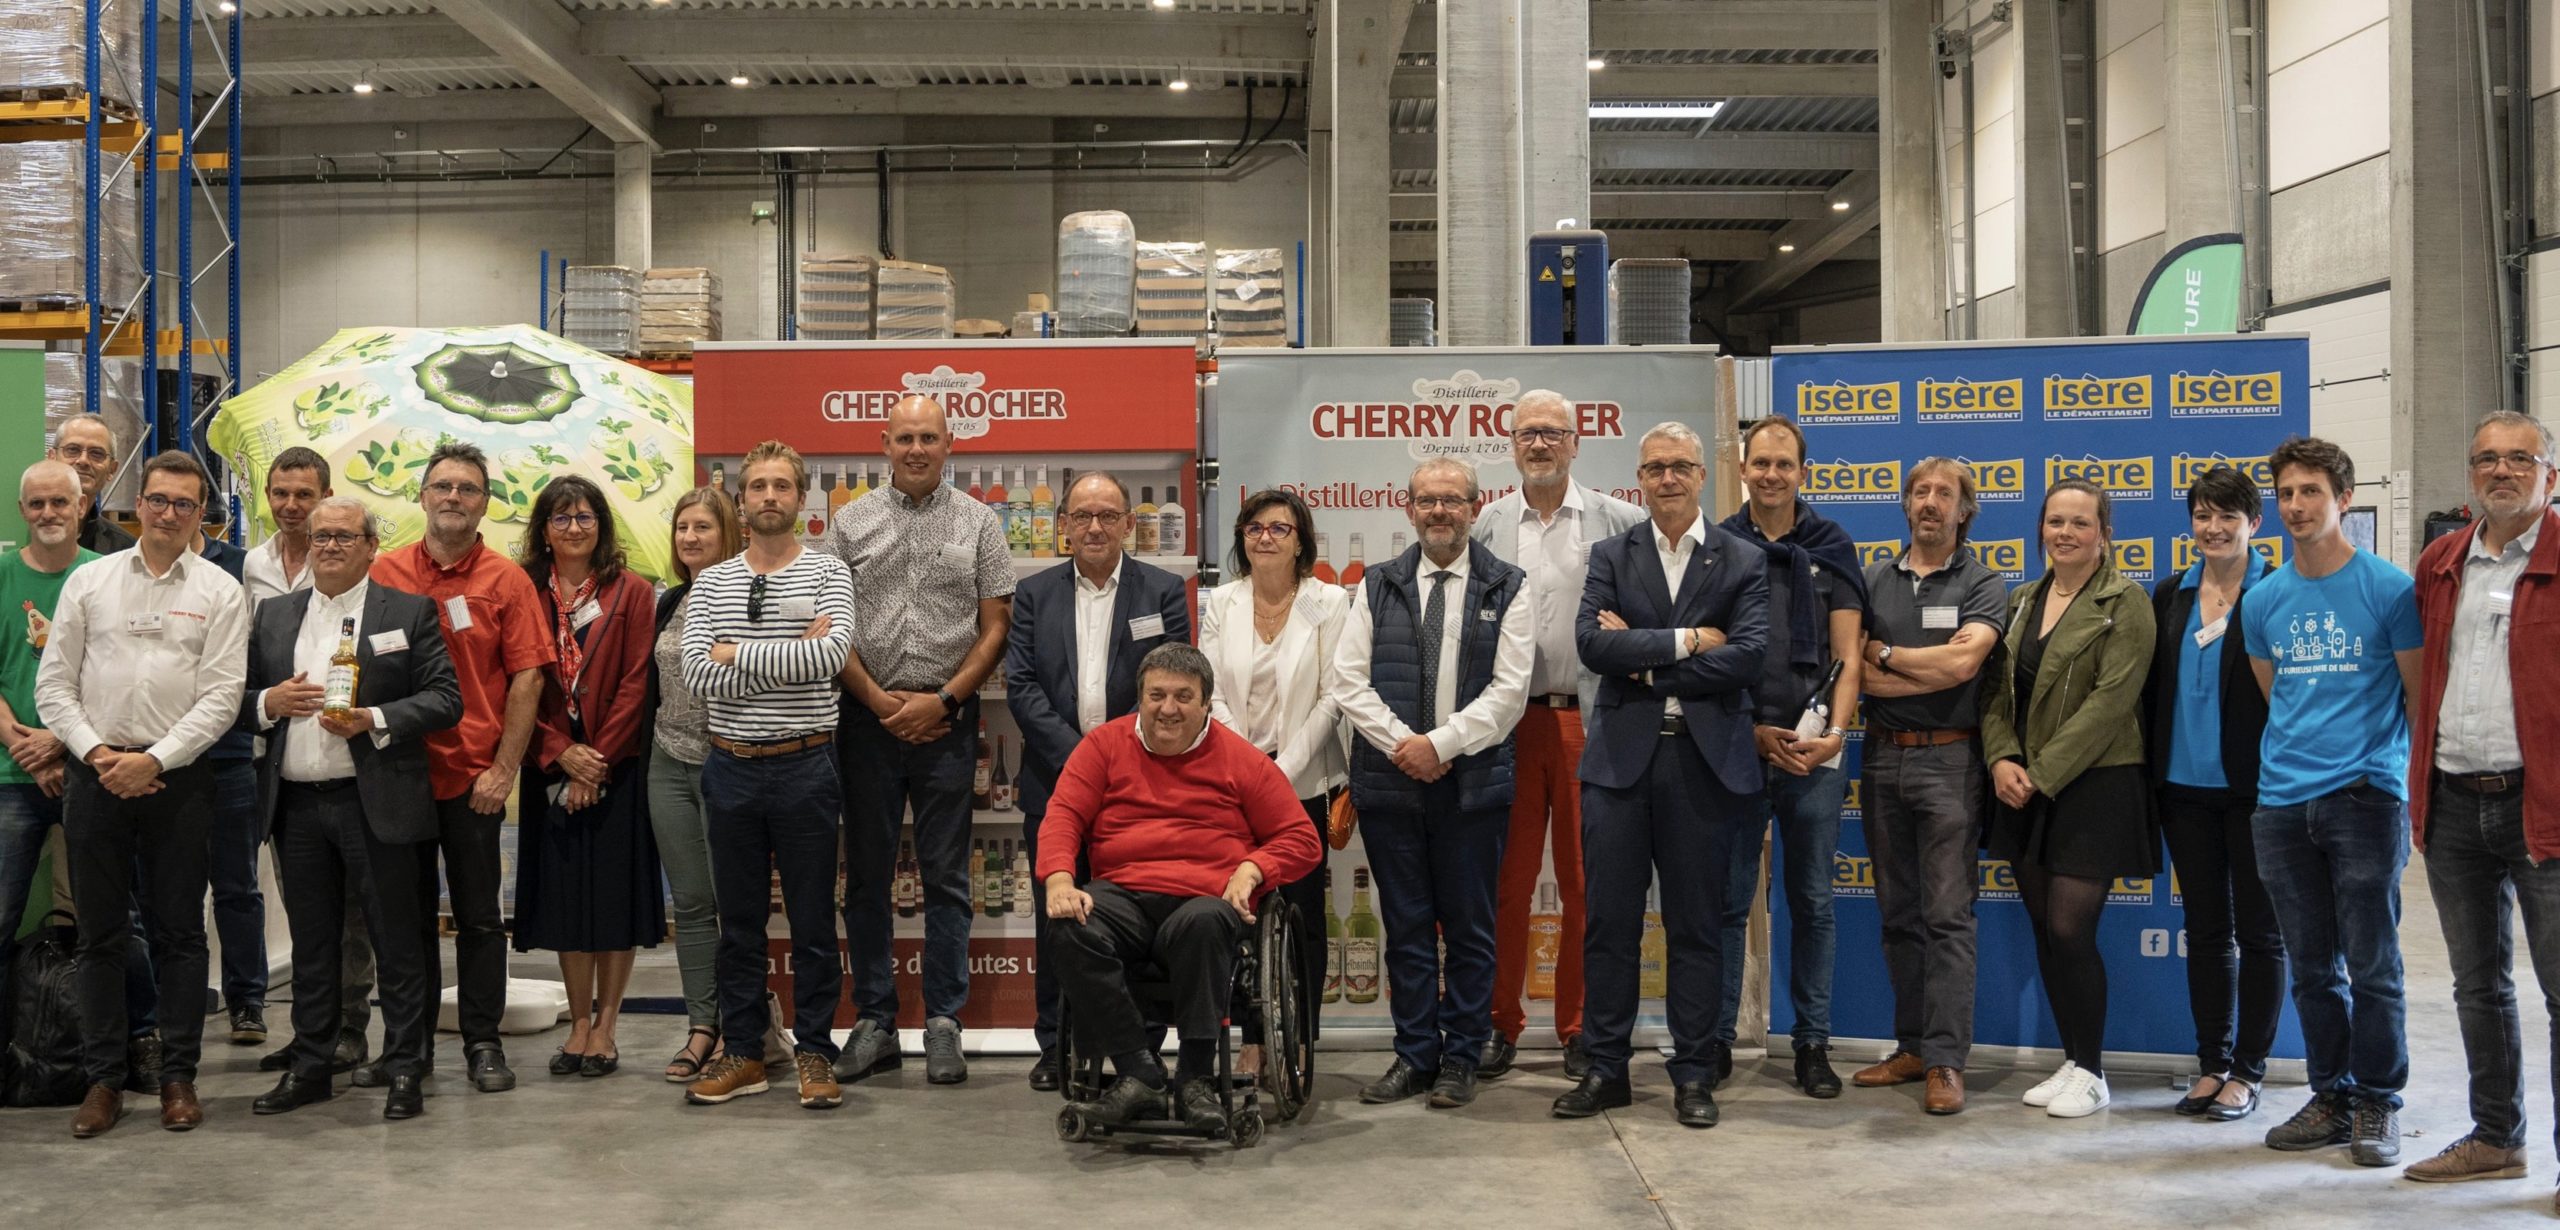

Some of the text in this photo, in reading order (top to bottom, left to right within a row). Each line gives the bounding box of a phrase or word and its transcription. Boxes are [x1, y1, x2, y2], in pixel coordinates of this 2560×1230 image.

[917, 378, 969, 390] Distillerie
[2051, 373, 2144, 406] isère
[2178, 369, 2273, 403] isère
[1432, 386, 1498, 399] Distillerie
[1804, 380, 1893, 411] isère
[1924, 376, 2015, 409] isère
[824, 391, 1066, 419] CHER ROCHER
[2189, 405, 2278, 415] DÉPARTEMENT
[1815, 414, 1898, 423] DÉPARTEMENT
[1936, 411, 2020, 421] DÉPARTEMENT
[2063, 408, 2149, 418] DÉPARTEMENT
[951, 422, 977, 431] 1705
[1312, 403, 1623, 438] CHERRY ROER
[1422, 442, 1509, 456] Depuis 1705
[1805, 458, 1894, 490] isère
[1815, 492, 1898, 501] DÉPARTEMENT
[2329, 663, 2338, 672] DE
[967, 953, 1019, 975] utes
